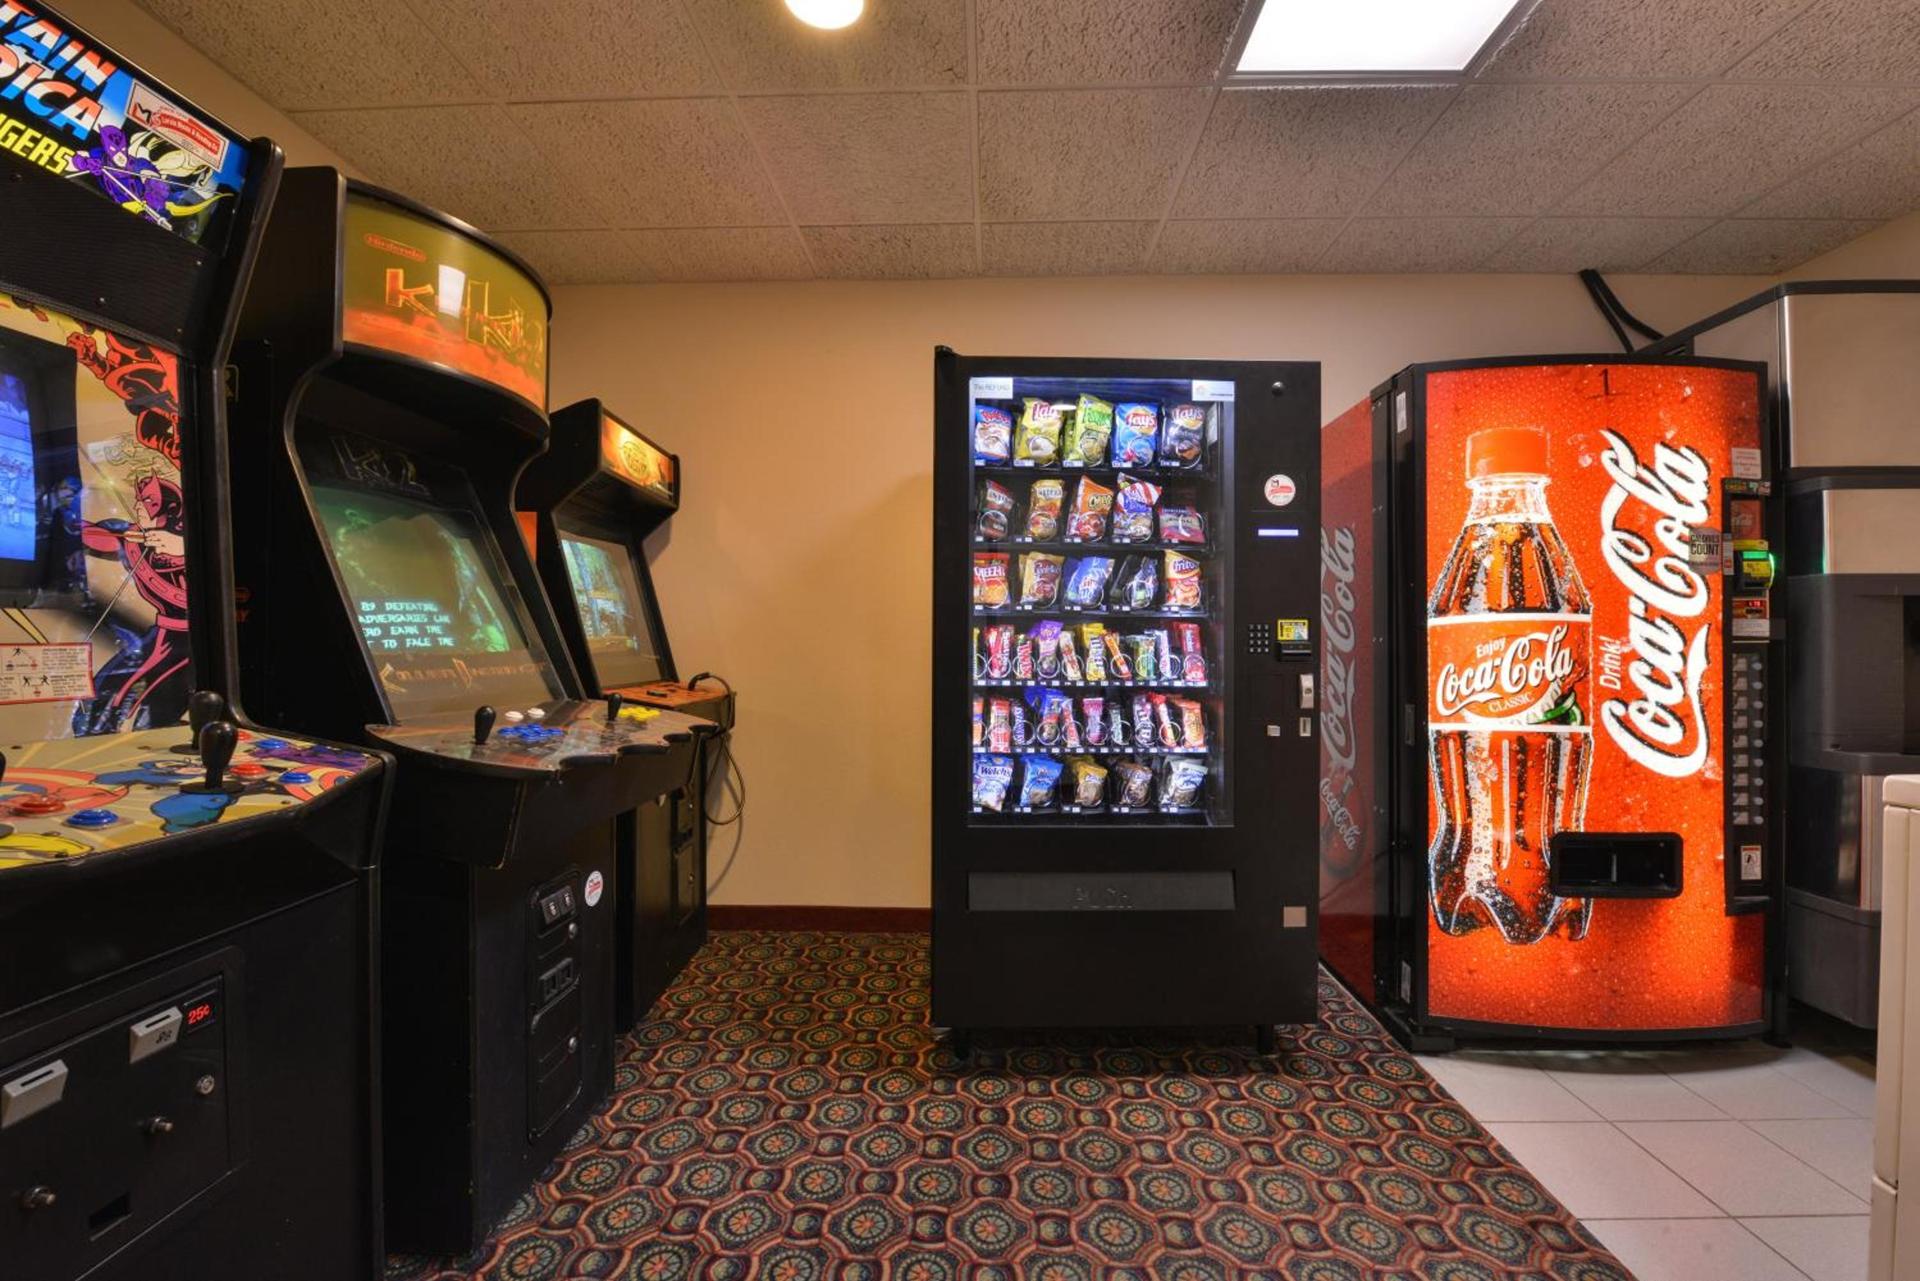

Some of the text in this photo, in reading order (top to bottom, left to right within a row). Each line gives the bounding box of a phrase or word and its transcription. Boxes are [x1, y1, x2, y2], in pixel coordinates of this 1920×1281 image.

[0, 113, 75, 176] GERS
[1691, 544, 1719, 555] COUNT
[1601, 428, 1711, 778] Coca-Cola
[1475, 638, 1506, 659] Enjoy
[1600, 636, 1622, 691] Drink!
[1437, 624, 1573, 717] Coca-Cola
[1487, 693, 1534, 714] CLASSIC
[188, 1004, 210, 1024] 25¢
